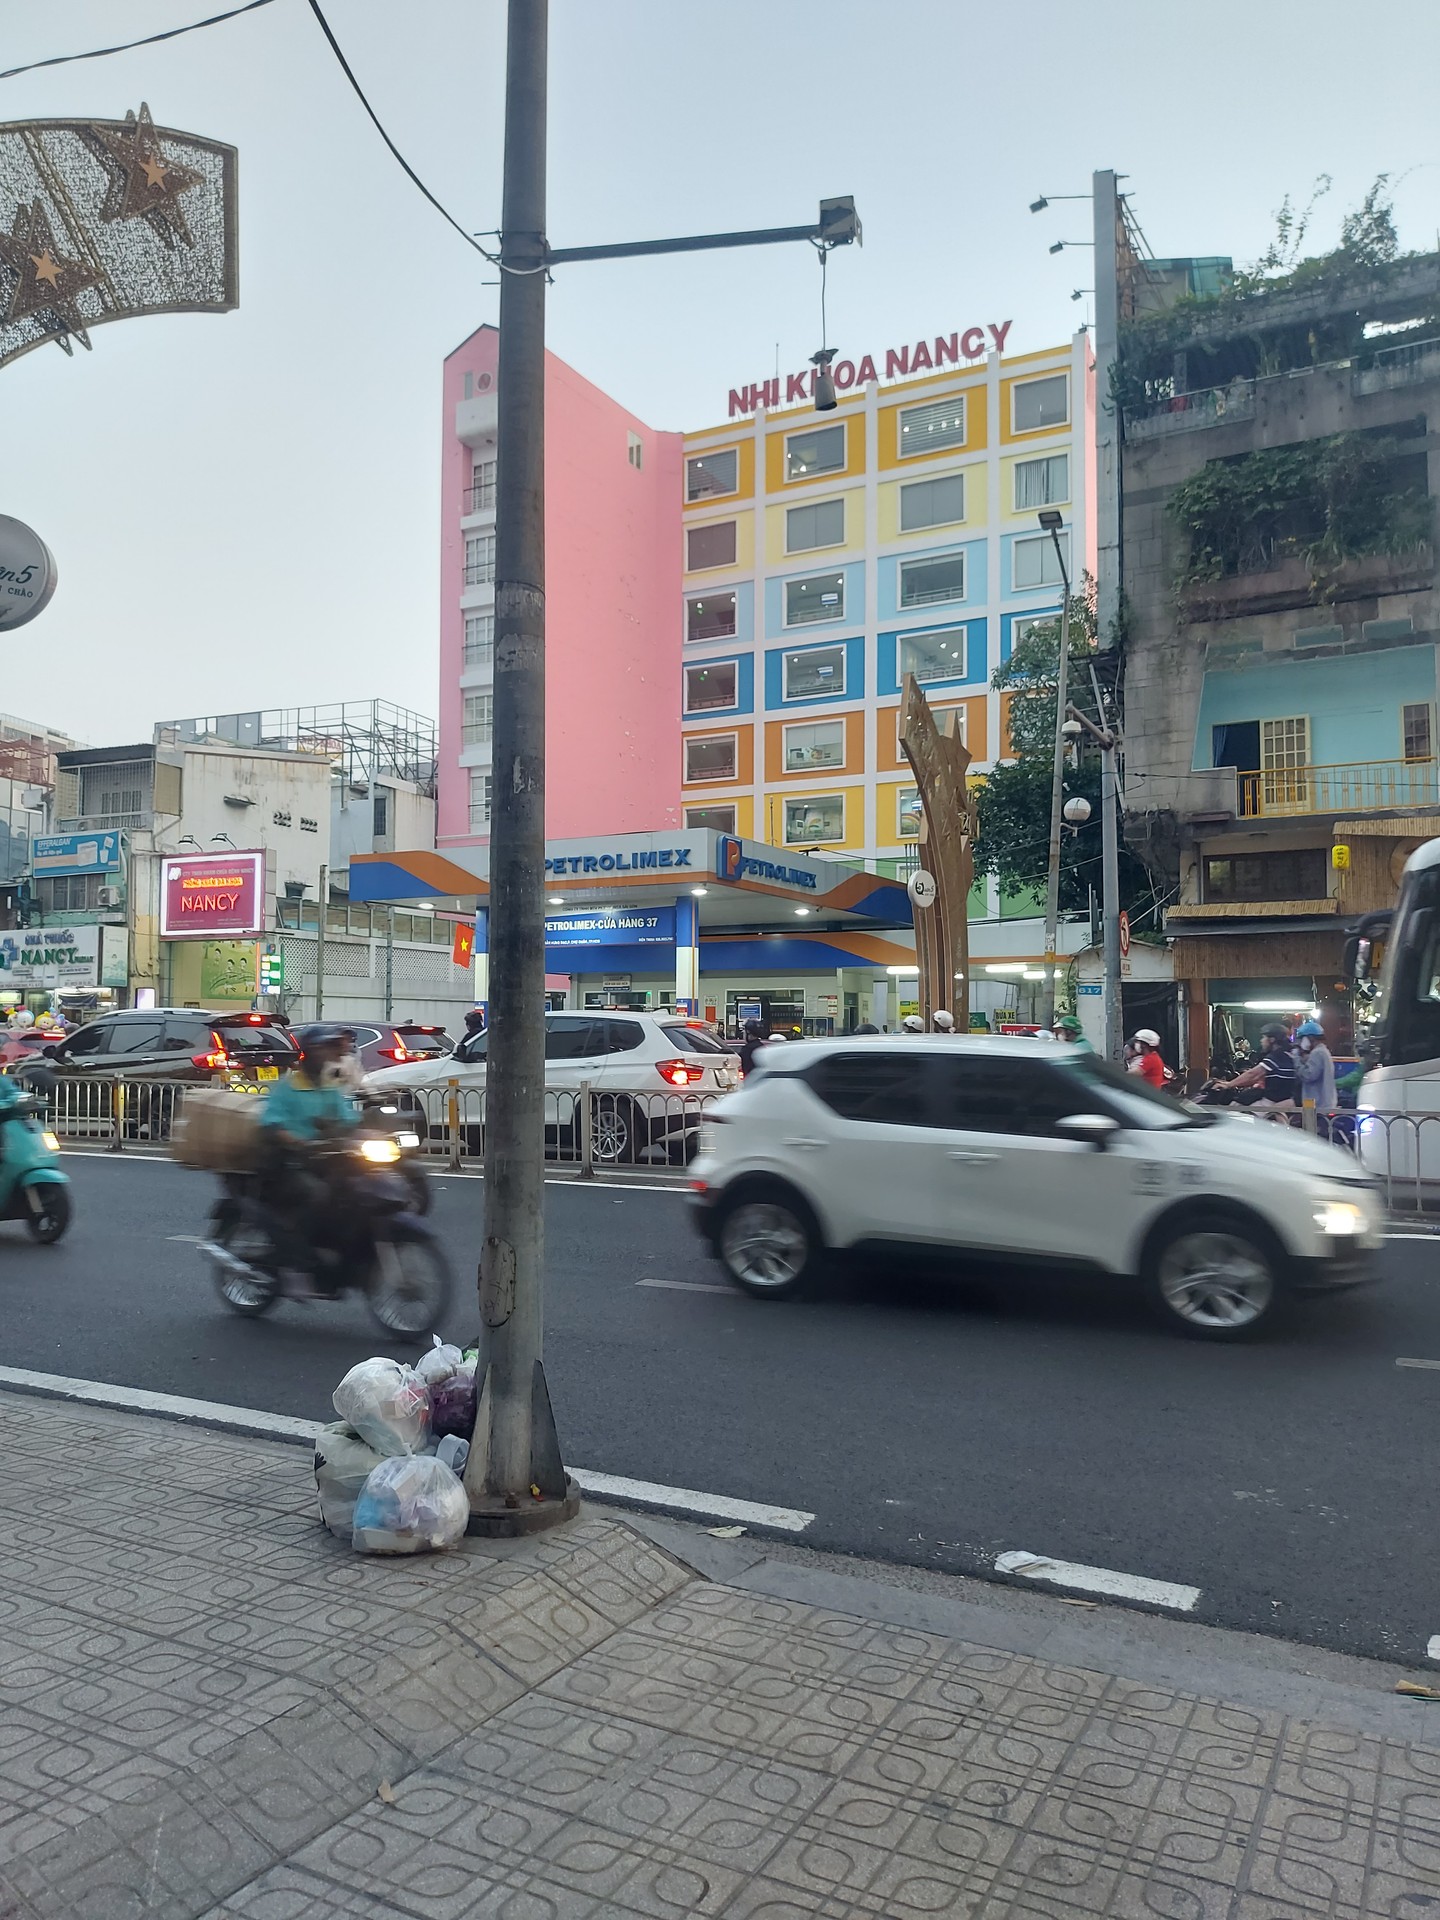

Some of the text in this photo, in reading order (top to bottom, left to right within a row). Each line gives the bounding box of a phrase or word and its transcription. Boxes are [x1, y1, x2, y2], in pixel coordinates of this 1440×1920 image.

[728, 379, 779, 416] NHI
[886, 320, 1013, 378] NANCY
[7, 587, 34, 598] CHÀO
[544, 848, 692, 874] PETROLIMEX
[742, 857, 817, 888] PETROLIMEX
[181, 893, 238, 912] NANCY
[618, 916, 644, 928] HÀNG
[646, 918, 658, 928] 37
[44, 929, 74, 944] THUỐC
[20, 948, 78, 965] NANCY
[1008, 1012, 1015, 1020] XE
